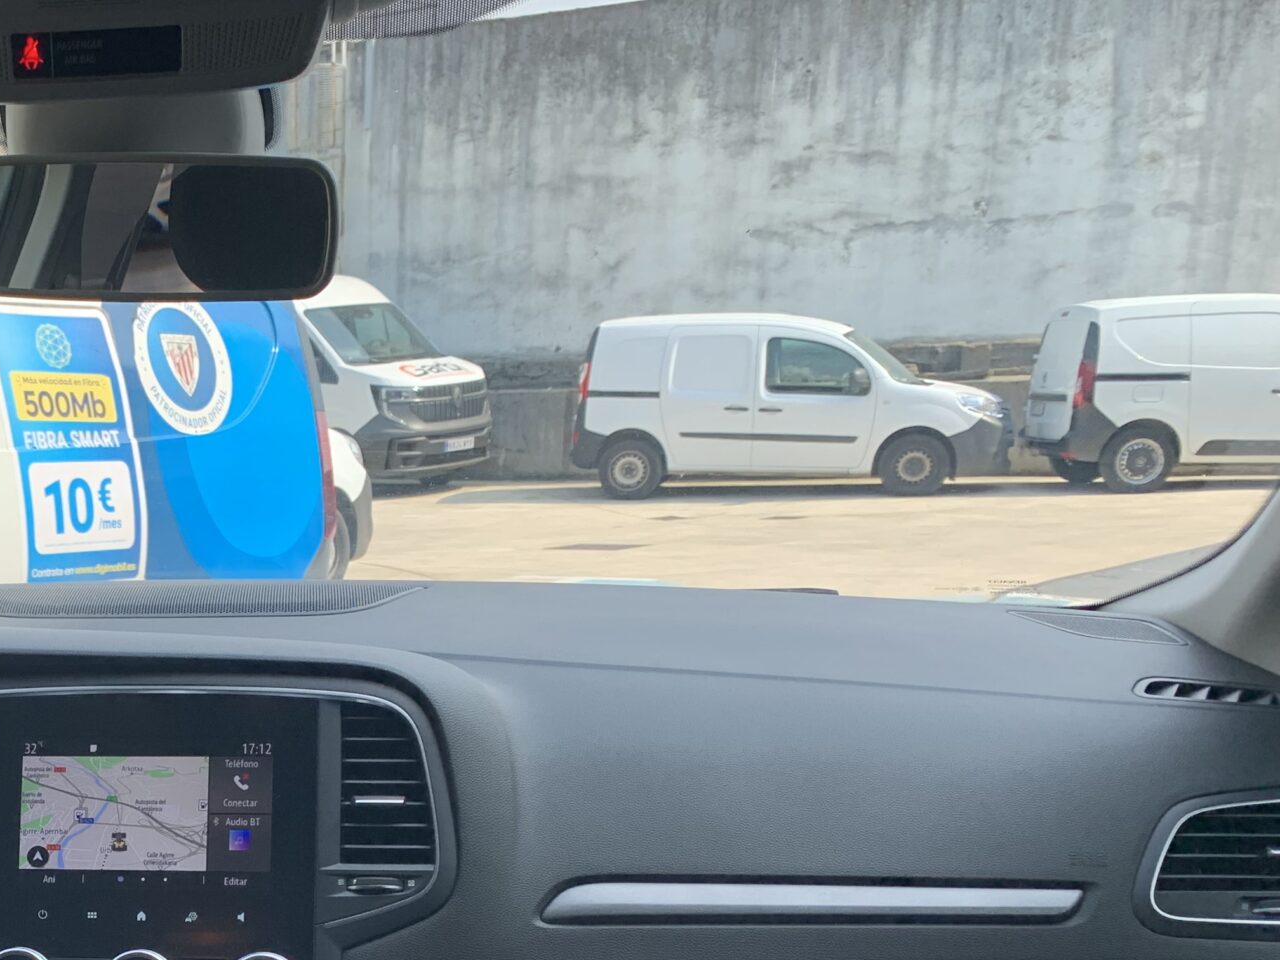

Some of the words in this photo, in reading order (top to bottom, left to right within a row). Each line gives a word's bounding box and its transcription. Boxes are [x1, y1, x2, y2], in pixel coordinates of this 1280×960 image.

[38, 377, 72, 385] velocidad
[82, 378, 100, 386] Fibra
[23, 390, 106, 418] 500Mb
[150, 385, 208, 428] PATROCINADOR
[207, 390, 227, 422] OFICIAL
[23, 430, 70, 450] FIBRA
[70, 430, 121, 448] SMART
[24, 743, 37, 754] 32
[242, 743, 272, 755] 17:12
[224, 758, 259, 769] Teléfono
[222, 798, 259, 808] Conectar
[225, 817, 248, 827] Audio
[249, 818, 260, 826] BT
[223, 877, 248, 886] Editar
